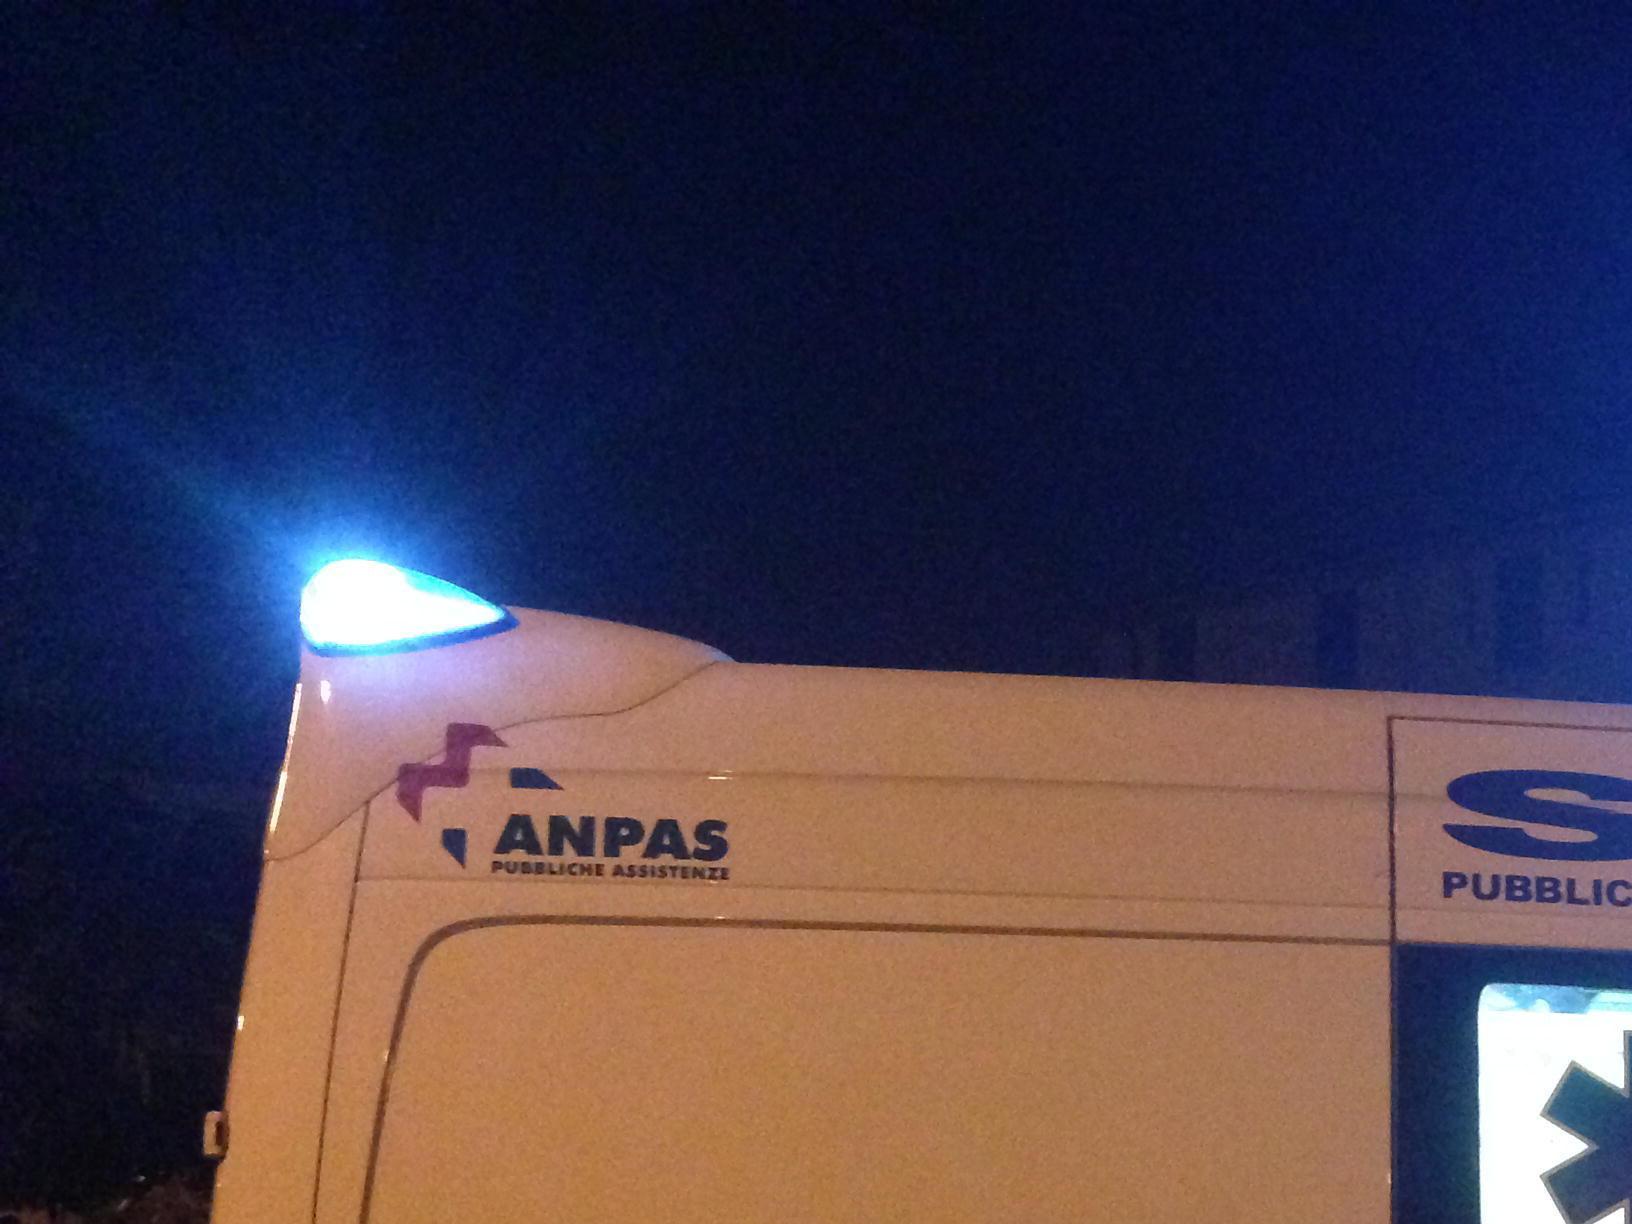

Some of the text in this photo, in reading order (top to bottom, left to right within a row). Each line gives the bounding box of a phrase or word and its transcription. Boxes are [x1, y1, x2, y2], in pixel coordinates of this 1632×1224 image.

[493, 813, 729, 861] ANPAS
[491, 860, 730, 881] PUBBLICHE ASSISTENZE
